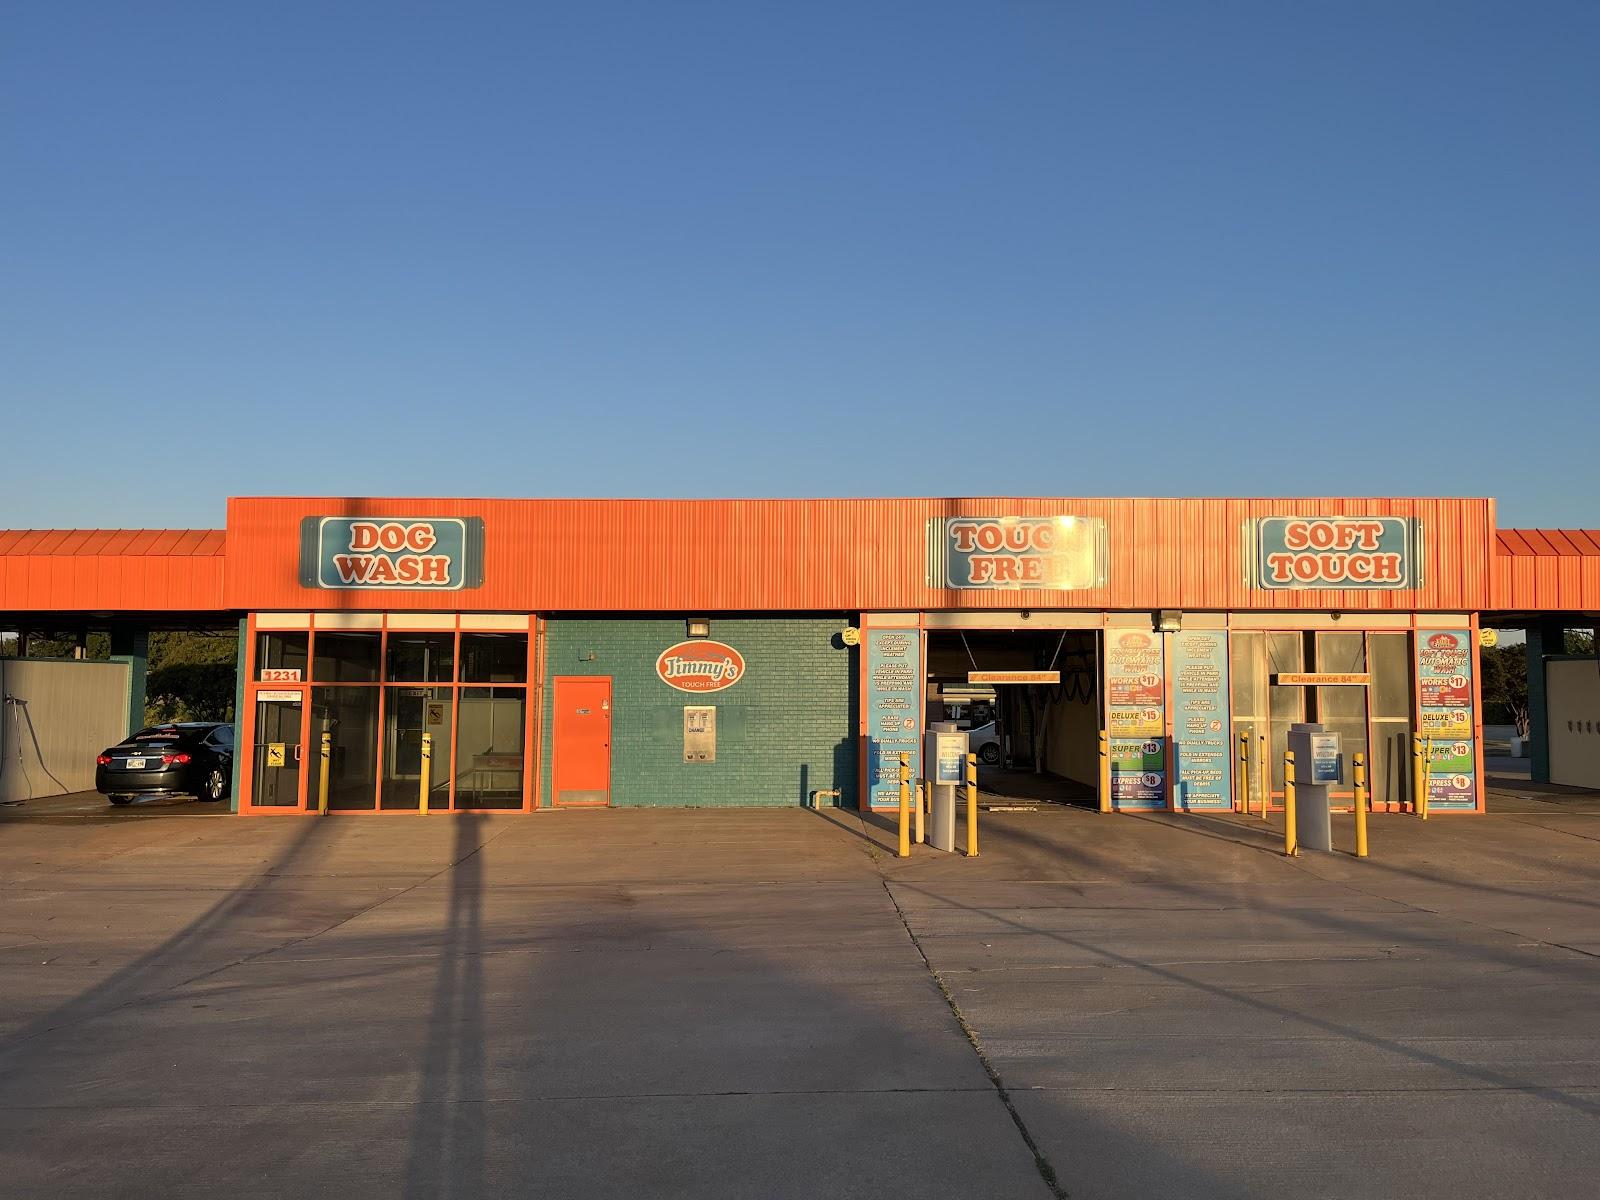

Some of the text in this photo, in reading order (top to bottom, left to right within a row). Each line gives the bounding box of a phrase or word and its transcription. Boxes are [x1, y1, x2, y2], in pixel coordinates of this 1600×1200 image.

[350, 524, 435, 551] DOG
[951, 524, 1056, 551] TOUC
[1286, 523, 1382, 549] SOFT
[335, 555, 449, 582] WASH
[1268, 554, 1401, 581] TOUCH
[1420, 658, 1467, 666] AUTOMATIC
[665, 657, 736, 681] Jimmy's
[1110, 675, 1155, 685] WORKS $17
[1291, 675, 1338, 683] Clearance
[1450, 677, 1463, 687] $17
[1111, 711, 1157, 720] DELUXE $15
[1451, 712, 1465, 721] $15
[1143, 743, 1157, 753] $13
[1452, 745, 1466, 754] $13
[1112, 775, 1156, 785] EXPRESS $8
[1429, 777, 1465, 787] XPRESS $8
